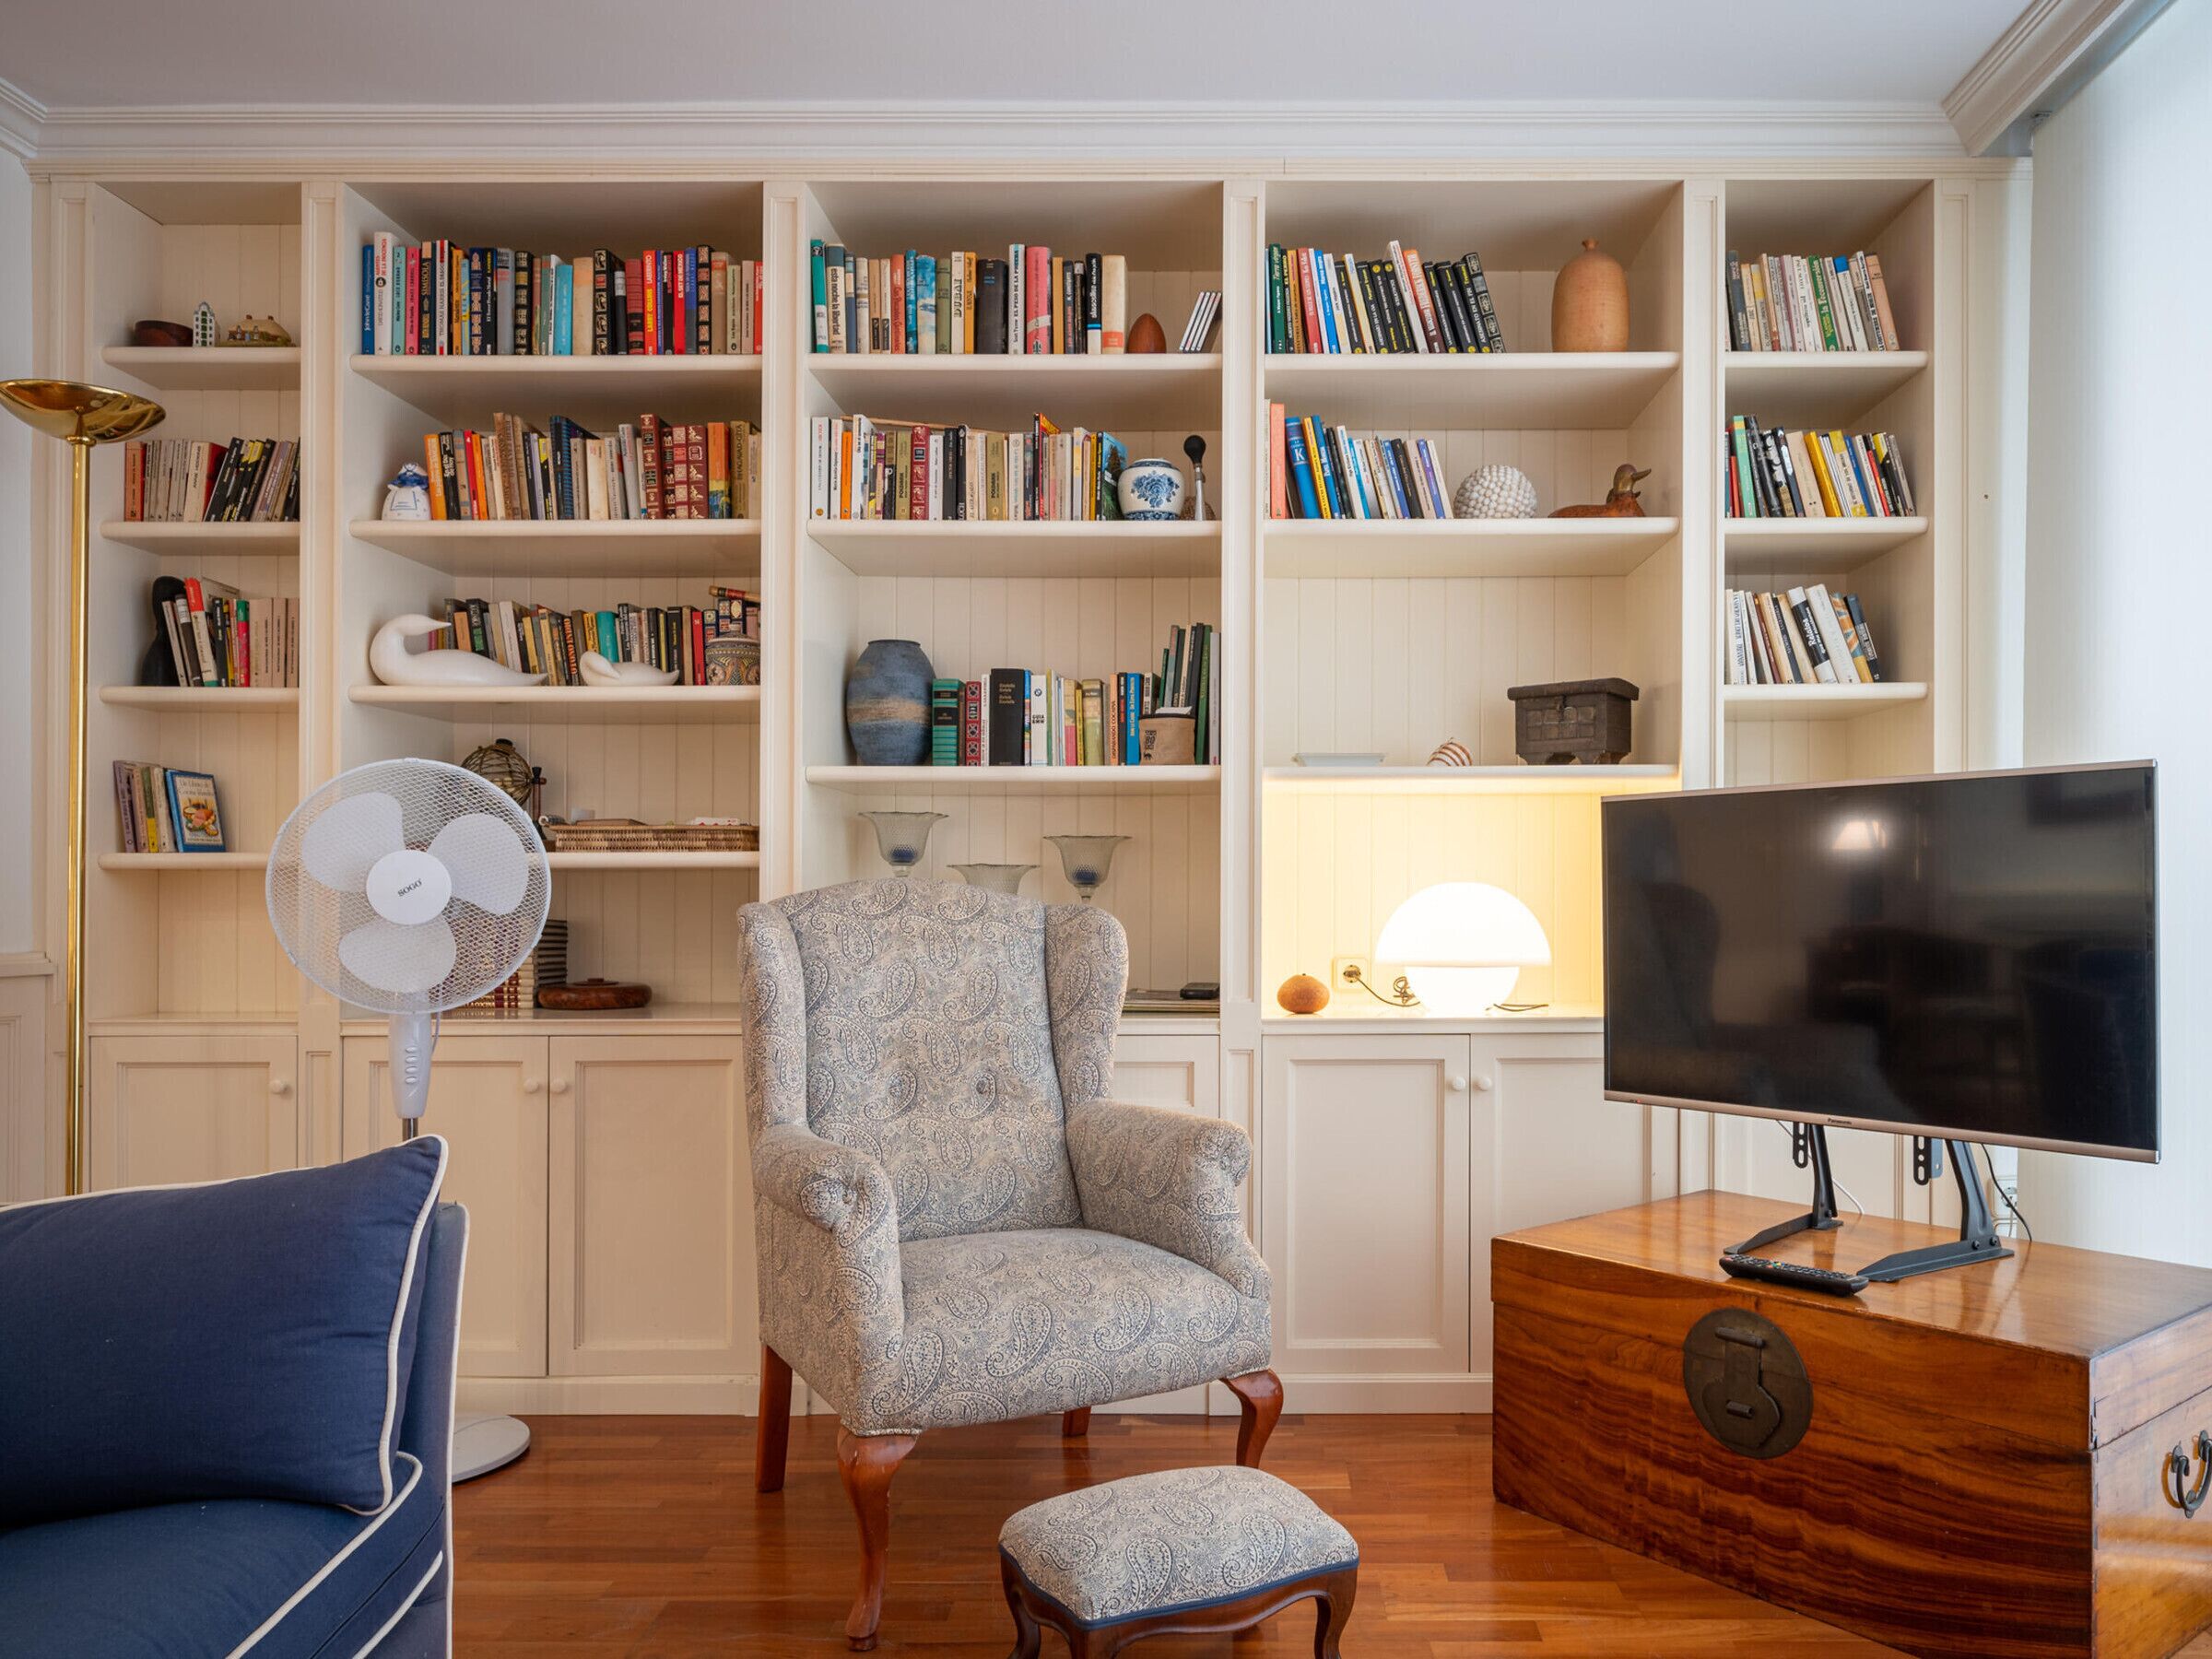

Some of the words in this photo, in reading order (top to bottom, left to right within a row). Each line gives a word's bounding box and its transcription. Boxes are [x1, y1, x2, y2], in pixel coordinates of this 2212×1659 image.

[831, 283, 840, 303] noche
[954, 279, 962, 317] DUBAI
[1475, 313, 1486, 343] ASESINATO
[1803, 618, 1817, 645] Relatos
[397, 879, 422, 897] SOGO
